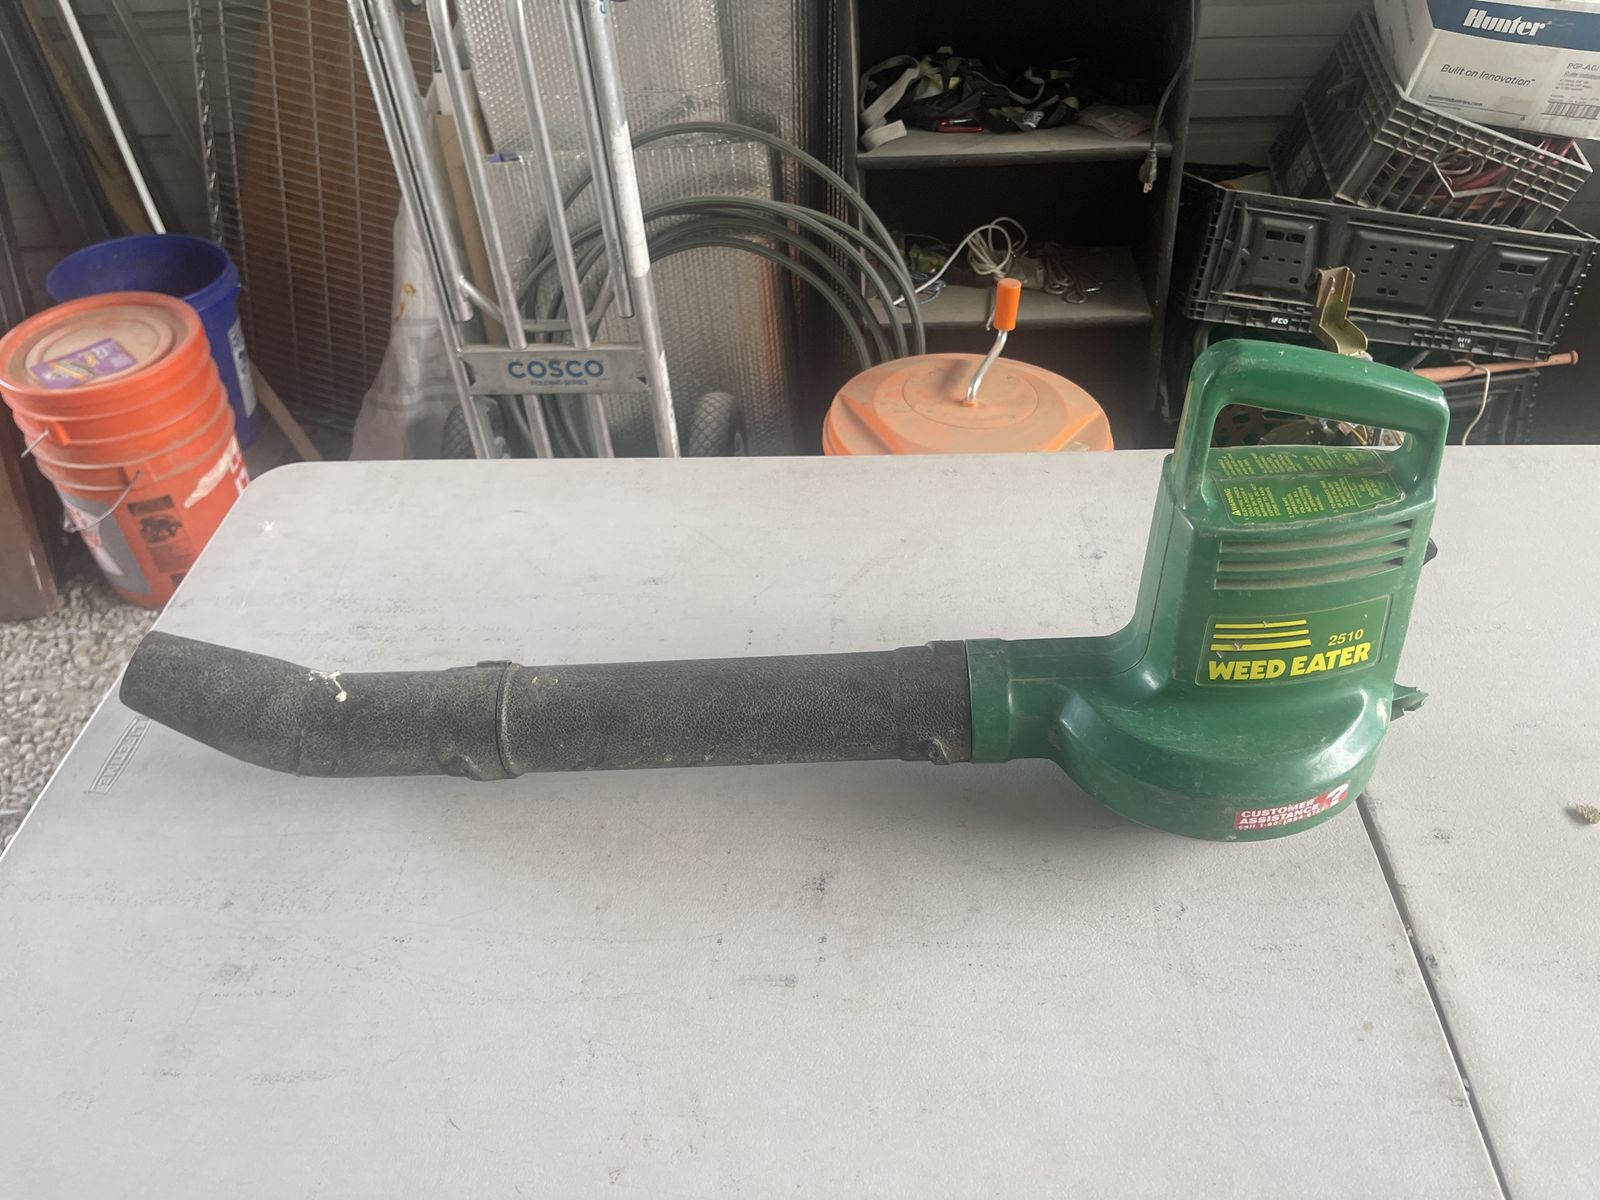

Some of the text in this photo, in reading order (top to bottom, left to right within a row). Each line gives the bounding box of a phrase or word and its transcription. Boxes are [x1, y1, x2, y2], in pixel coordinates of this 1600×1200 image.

[1463, 8, 1546, 37] Hunter
[1440, 63, 1465, 76] Built
[1465, 69, 1479, 78] on
[1271, 317, 1289, 325] IFCO
[507, 359, 604, 379] COSCO
[1328, 628, 1364, 647] 2510
[1208, 642, 1372, 681] WEED EATER
[1240, 802, 1320, 824] ASSISTANCE
[1241, 799, 1315, 818] CUSTOMER
